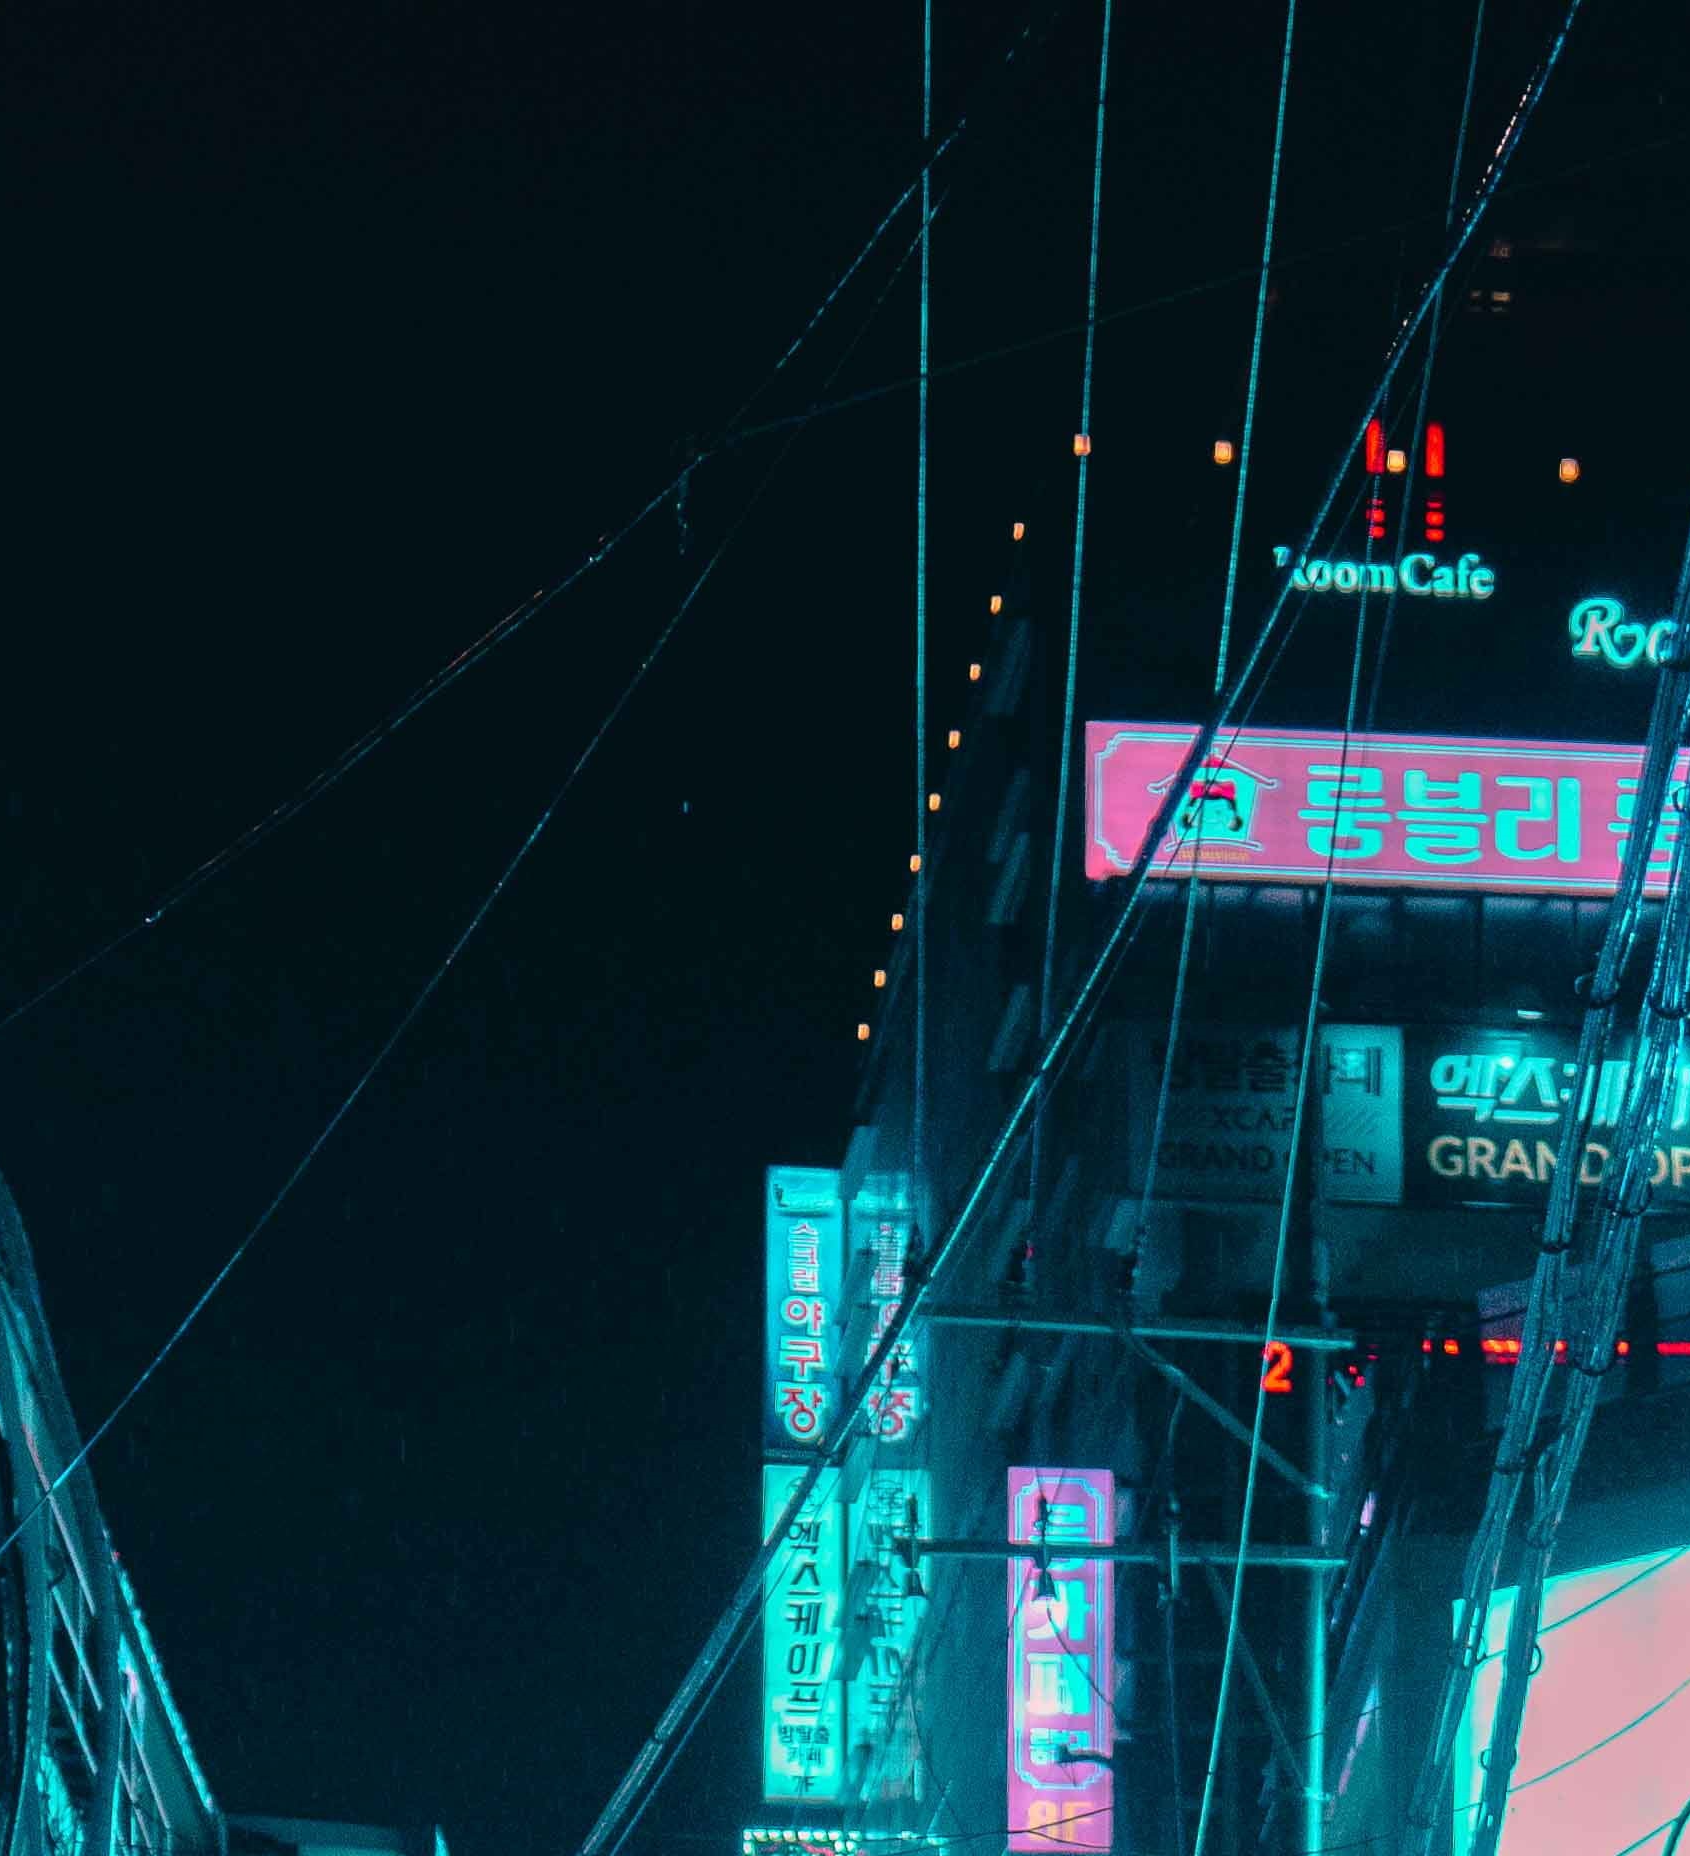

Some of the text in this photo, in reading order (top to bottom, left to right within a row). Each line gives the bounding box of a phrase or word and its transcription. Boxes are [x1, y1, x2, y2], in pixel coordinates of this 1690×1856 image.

[1399, 553, 1494, 599] Cafe
[1298, 762, 1581, 866] 룸블리
[1427, 1136, 1609, 1188] GRAND
[778, 1298, 826, 1436] 야구장
[787, 1521, 822, 1714] 엑스케이프
